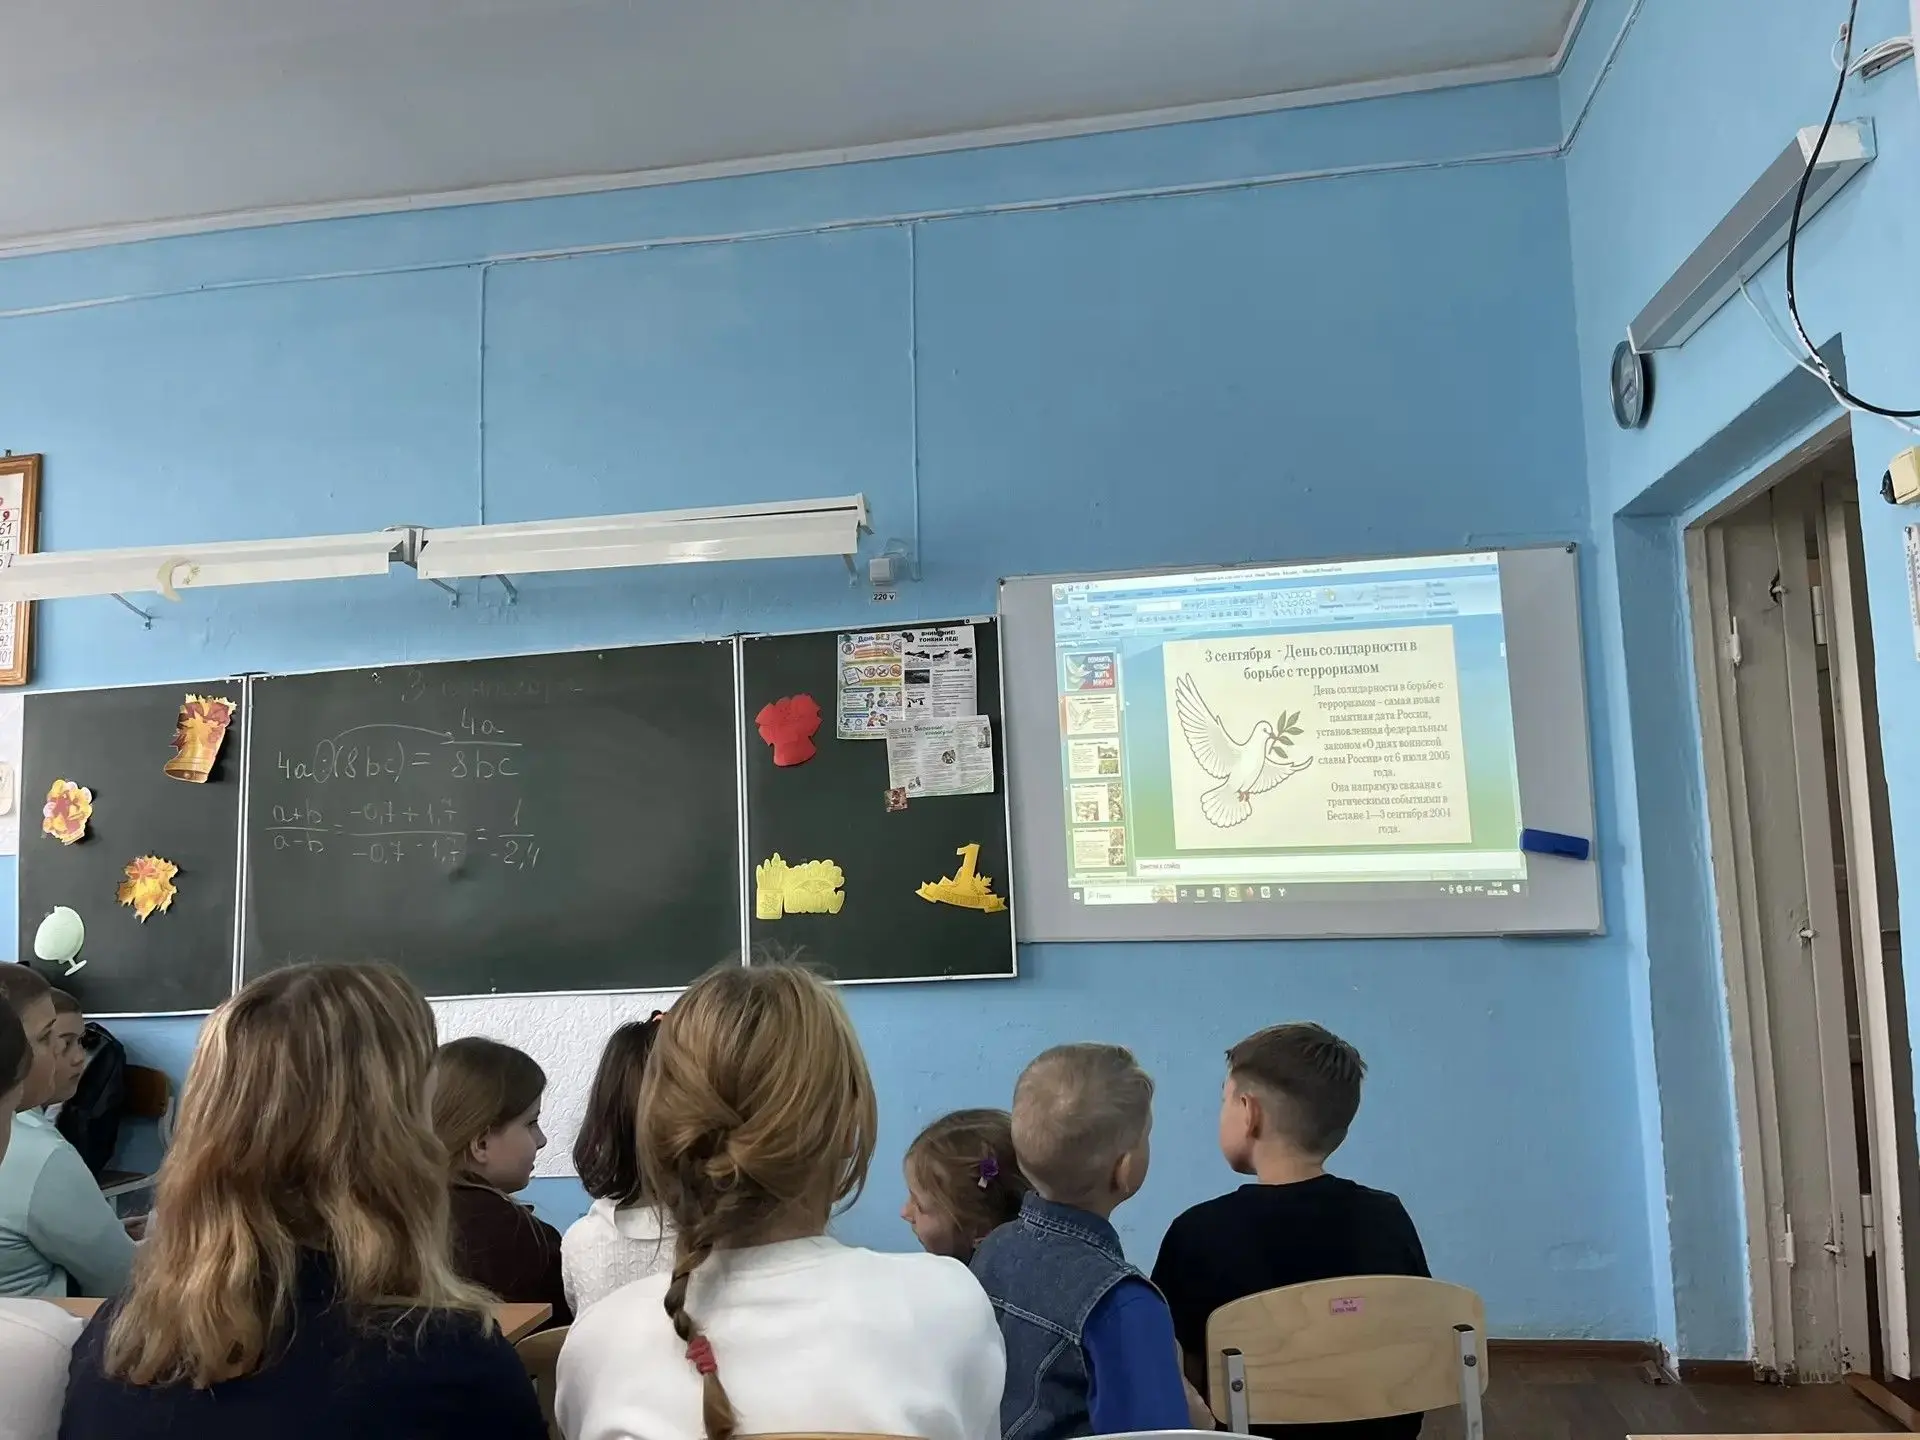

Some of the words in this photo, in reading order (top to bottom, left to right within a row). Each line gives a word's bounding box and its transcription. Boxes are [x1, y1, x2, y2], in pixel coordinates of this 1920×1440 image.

[3, 510, 10, 521] 9
[1205, 650, 1212, 662] 3
[1215, 647, 1271, 664] сентября
[1284, 644, 1317, 660] День
[1319, 641, 1406, 659] солидарности
[1409, 641, 1417, 651] в
[1244, 665, 1286, 681] борьбе
[1287, 668, 1294, 678] с
[1296, 663, 1379, 680] терроризмом
[1313, 685, 1336, 696] День
[1336, 684, 1398, 696] солидарности
[1406, 680, 1437, 693] борьбе
[1318, 698, 1376, 710] терроризмом
[1384, 698, 1411, 706] самая
[1413, 696, 1440, 704] новая
[1329, 713, 1373, 723] памятная
[1375, 712, 1394, 721] дата
[1316, 728, 1382, 739] установленная
[1384, 724, 1448, 736] федеральным
[1324, 742, 1360, 751] законом
[1375, 741, 1398, 749] днях
[1399, 737, 1441, 748] воинской
[1318, 756, 1346, 765] славы
[1383, 755, 1393, 763] от
[1395, 752, 1401, 762] 6
[1402, 754, 1427, 762] июля
[1428, 751, 1450, 761] 2005
[1373, 768, 1395, 777] года.
[1331, 782, 1350, 792] Она
[1351, 783, 1398, 793] напрямую
[1399, 781, 1435, 789] связана
[1327, 797, 1390, 808] трагическими
[1391, 794, 1441, 804] событиями
[1327, 810, 1365, 821] Беслане
[1386, 808, 1428, 820] сентября
[1378, 825, 1401, 834] года.
